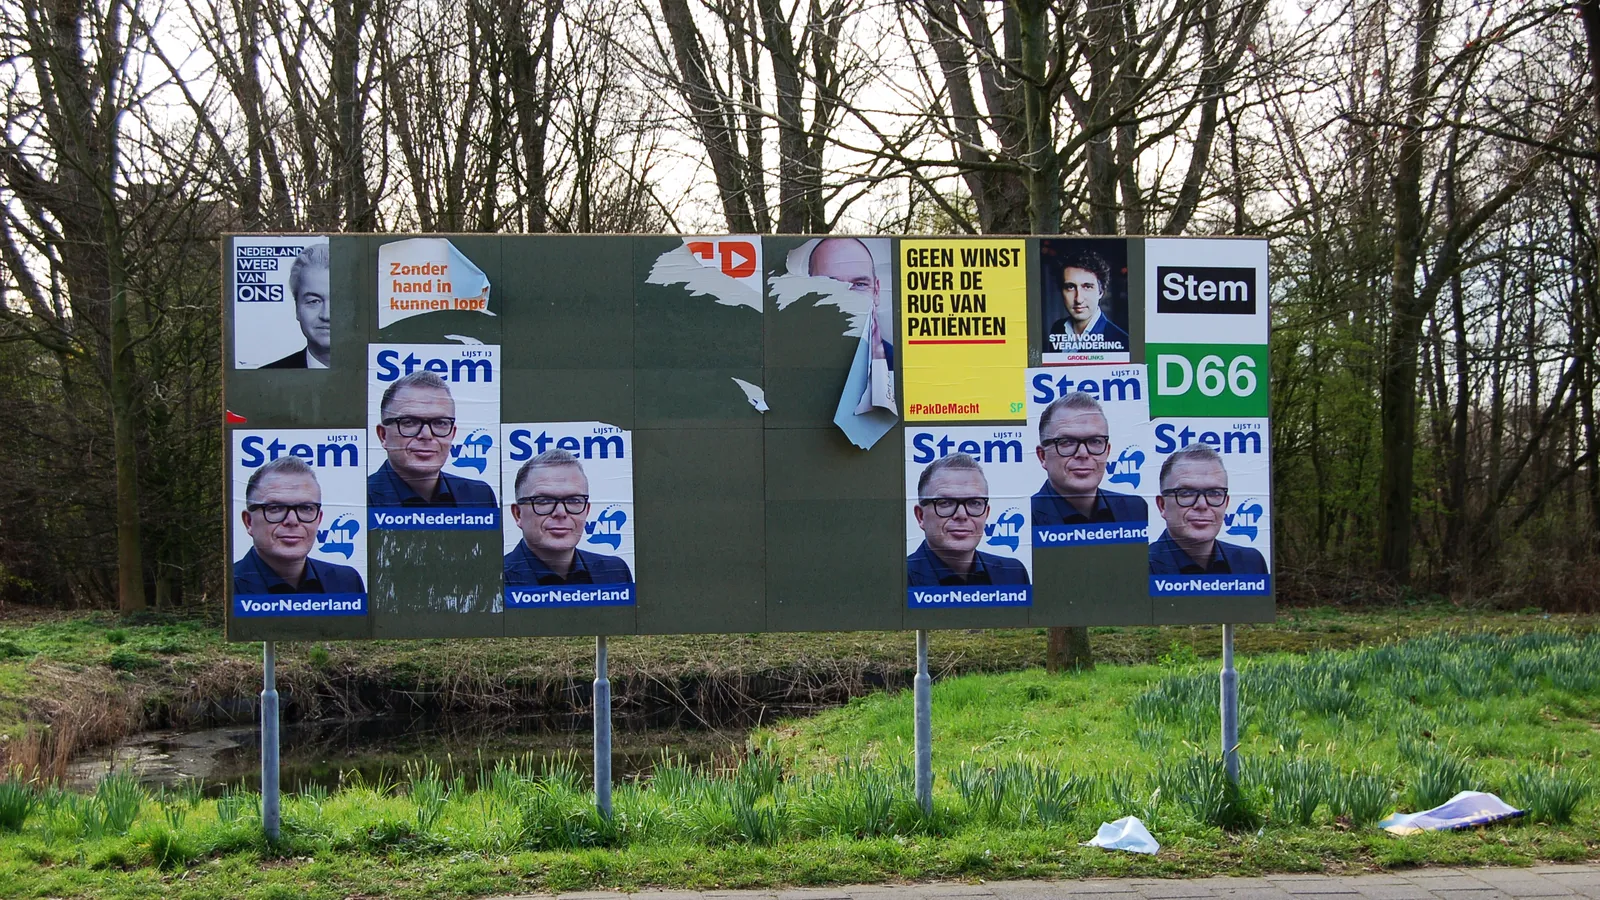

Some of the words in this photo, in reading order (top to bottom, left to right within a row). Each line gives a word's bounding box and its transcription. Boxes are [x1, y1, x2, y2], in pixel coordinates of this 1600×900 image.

[237, 247, 303, 257] NEDERLAND
[907, 248, 954, 268] GEEN
[960, 248, 1021, 268] WINST
[238, 259, 277, 270] WEER
[390, 262, 448, 276] Zonder
[238, 272, 266, 283] VAN
[907, 271, 954, 291] OVER
[960, 271, 983, 291] DE
[238, 286, 283, 301] ONS
[392, 279, 432, 293] hand
[437, 279, 452, 293] in
[1162, 272, 1248, 302] Stem
[390, 297, 449, 310] kunnen
[908, 294, 944, 314] RUG
[950, 294, 986, 313] VAN
[908, 312, 1006, 337] PATIËNTEN
[1048, 333, 1076, 342] STEM
[1076, 333, 1104, 342] VOOR
[1052, 341, 1125, 350] VERANDERING.
[376, 350, 493, 382] Stem
[1157, 354, 1257, 397] D66
[1032, 373, 1142, 404] Stem
[909, 403, 980, 415] #PakDeMacht
[1010, 402, 1025, 414] SP
[593, 427, 613, 435] LIJST
[509, 429, 625, 461] Stem
[1154, 424, 1262, 454] Stem
[241, 436, 358, 467] Stem
[912, 433, 1023, 464] Stem
[374, 513, 494, 525] VoorNederland
[1038, 526, 1149, 543] VoorNederland
[1154, 579, 1265, 592] VoorNederland
[511, 588, 630, 604] VoorNederland
[913, 589, 1027, 604] VoorNederland
[241, 598, 362, 612] VoorNederland
